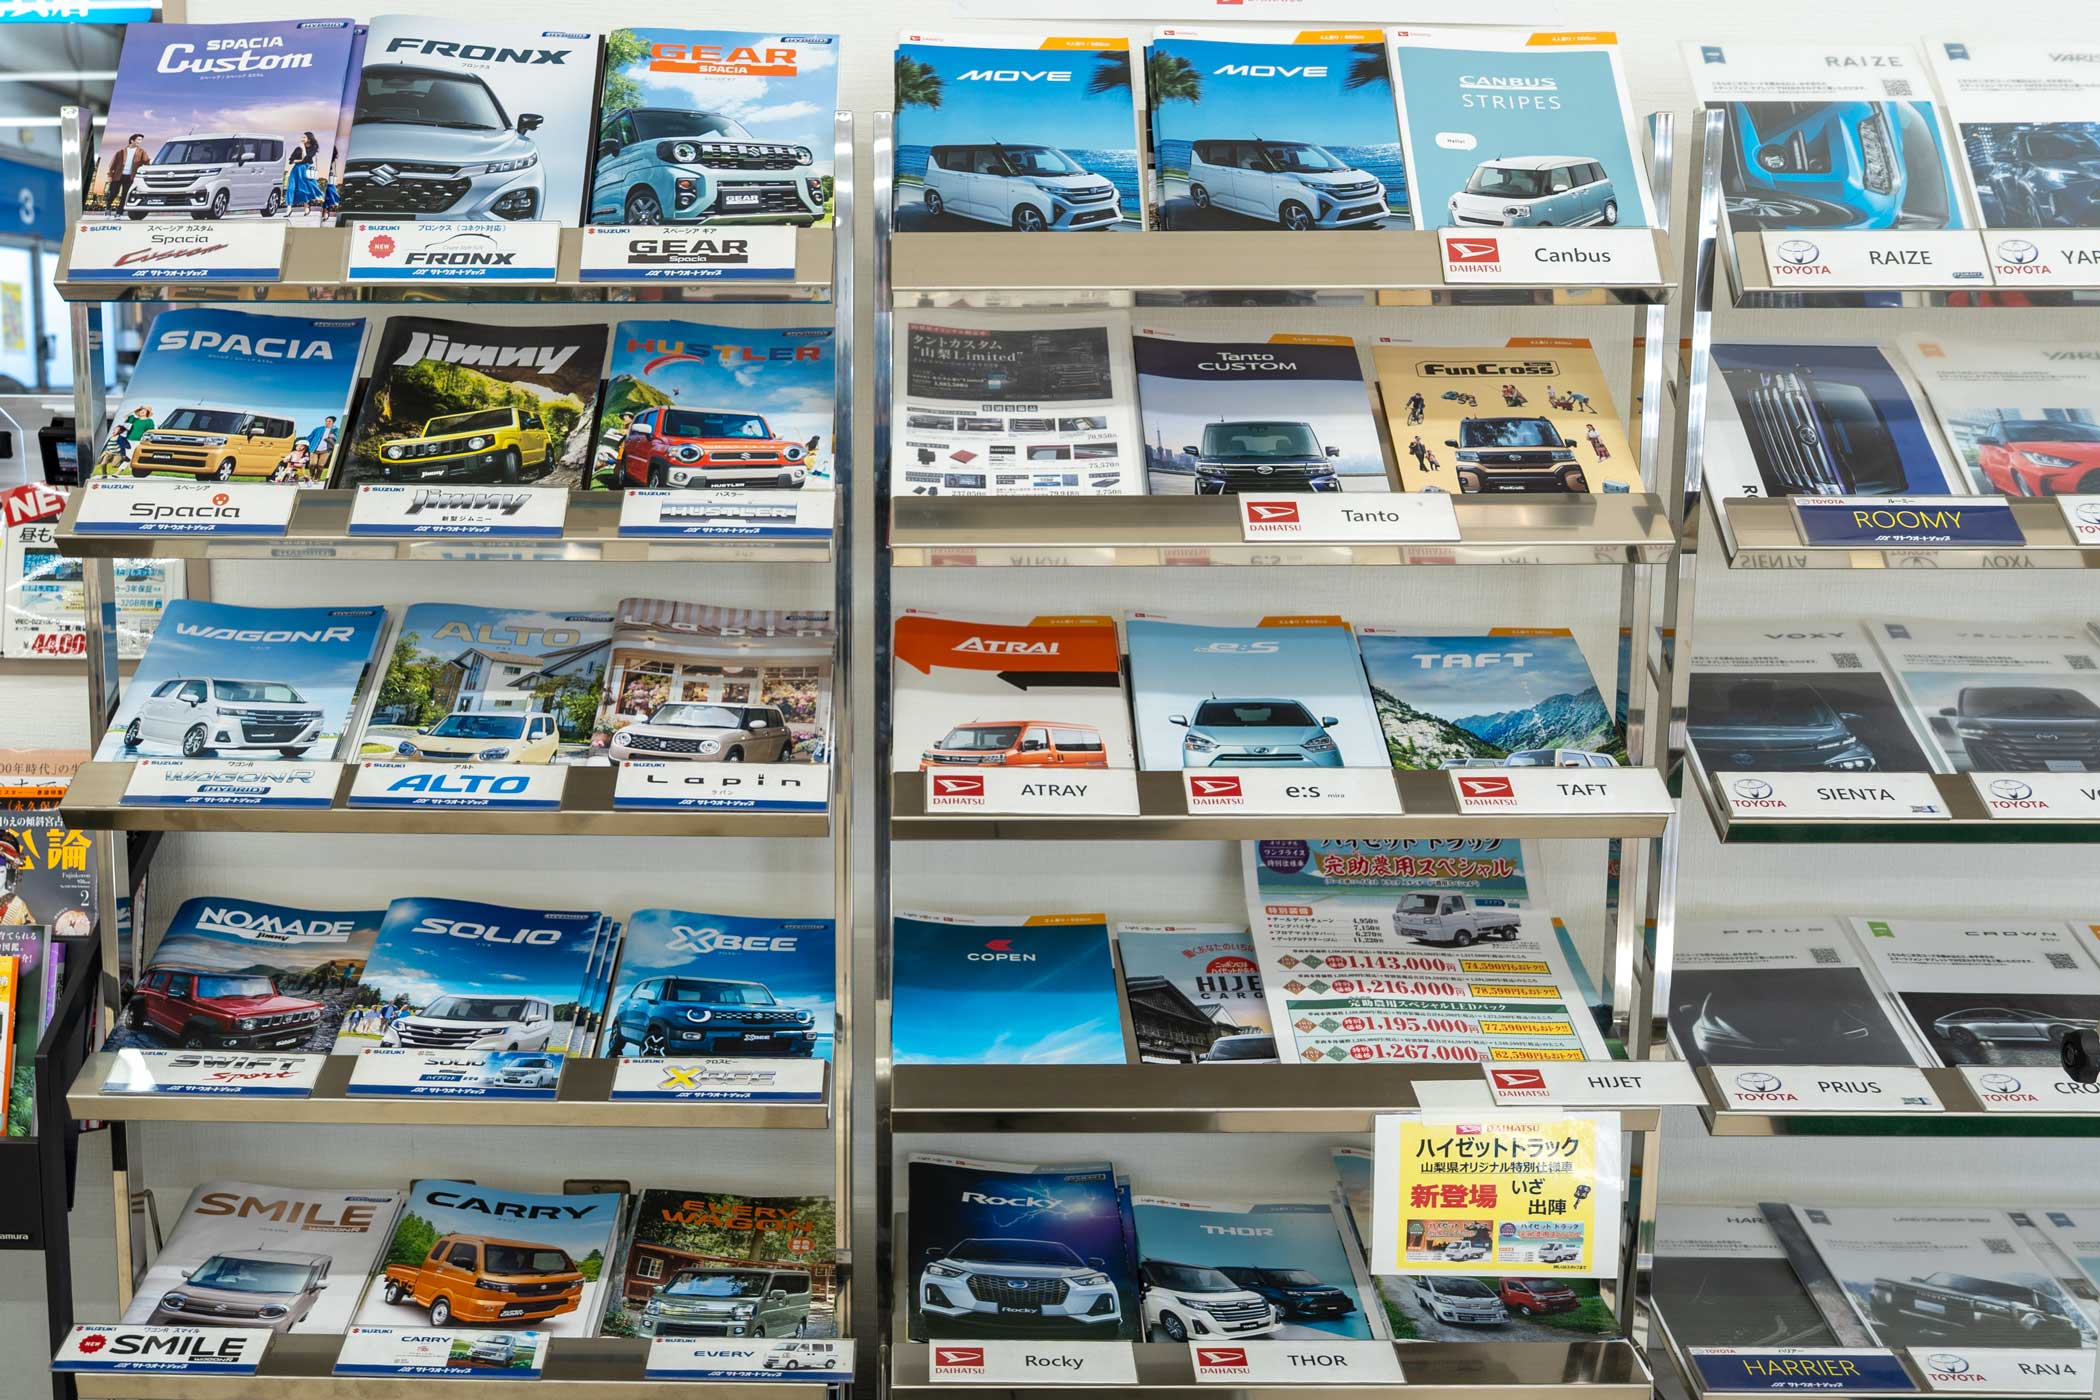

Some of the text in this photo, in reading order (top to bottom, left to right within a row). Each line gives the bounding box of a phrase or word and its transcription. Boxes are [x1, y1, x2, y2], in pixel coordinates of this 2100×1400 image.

[206, 36, 284, 50] SPACIA
[157, 43, 313, 74] Custom
[386, 38, 573, 65] FRONX
[650, 43, 797, 65] GEAR
[1824, 56, 1904, 67] RAIZE
[699, 65, 748, 74] SPACIA
[956, 70, 1073, 82] MOVE
[1213, 64, 1328, 78] MOVE
[1460, 75, 1557, 87] CANBUS
[1462, 94, 1561, 110] STRIPES
[19, 188, 34, 225] 3
[151, 234, 209, 245] Spacia
[628, 239, 748, 254] GEAR
[113, 244, 229, 267] Custom
[405, 252, 516, 265] FRONX
[669, 255, 707, 263] Spacia
[1534, 247, 1612, 263] Canbus
[1869, 250, 1933, 265] RAIZE
[1449, 264, 1502, 273] DAIHATSU
[1773, 265, 1831, 276] TOYOTA
[1995, 265, 2052, 275] TOYOTA
[156, 330, 334, 360] SPACIA
[626, 338, 821, 361] HUSTLER
[914, 335, 1003, 351] タントカスタム
[392, 331, 582, 375] Jimmy
[1216, 352, 1274, 361] Tanto
[1198, 362, 1297, 371] CUSTOM
[1424, 363, 1554, 376] FunCross
[129, 493, 240, 520] Spacia
[404, 489, 532, 515] Jimmy
[661, 504, 796, 518] HUSTLER
[1341, 509, 1400, 522] Tanto
[1853, 511, 1961, 529] ROOMY
[1249, 524, 1302, 532] DAIHATSU
[19, 528, 55, 543] 昼も
[432, 622, 581, 647] ALTO
[1764, 632, 1846, 640] VOXY
[952, 636, 1060, 655] ATRAI
[1411, 652, 1533, 669] TAFT
[386, 774, 531, 794] ALTO
[647, 774, 801, 787] Lapin
[204, 785, 263, 794] HYBRID
[1020, 784, 1088, 797] ATRAY
[1285, 784, 1321, 798] e:s
[1556, 784, 1607, 796] TAFT
[1816, 788, 1896, 801] SIENTA
[933, 797, 985, 806] DAIHATSU
[1192, 798, 1244, 806] DAIHATSU
[1465, 798, 1518, 806] DAIHATSU
[1732, 800, 1788, 809] TOYOTA
[1989, 801, 2050, 809] TOYOTA
[1323, 855, 1513, 878] 完助農用スペシャル
[80, 890, 90, 907] 2
[197, 906, 355, 937] NOMADE
[411, 918, 562, 945] SOLIO
[666, 925, 798, 953] XBEE
[967, 953, 1036, 961] COPEN
[168, 1055, 306, 1070] SWIFT
[424, 1058, 487, 1067] SOLIO
[202, 1071, 300, 1083] Sport
[658, 1064, 776, 1091] XBEE
[1587, 1076, 1642, 1089] HIJET
[1817, 1081, 1882, 1094] PRIUS
[2054, 1082, 2100, 1095] CRO
[1735, 1093, 1798, 1102] TOYOTA
[1981, 1094, 2039, 1103] TOYOTA
[1486, 1125, 1540, 1133] DAIHATSU
[1415, 1136, 1580, 1158] ハイゼットトラック
[1420, 1161, 1573, 1173] 山梨県オリジナル特別仕様車
[1511, 1178, 1546, 1196] いざ
[961, 1191, 1064, 1209] Rocky
[1411, 1184, 1498, 1209] 新登場
[194, 1192, 377, 1226] SMILE
[426, 1191, 599, 1220] CARRY
[682, 1200, 799, 1218] EVERY
[1528, 1199, 1567, 1216] 出陣
[662, 1209, 814, 1232] WAGON
[1200, 1225, 1275, 1238] THOR
[1001, 1306, 1038, 1314] Rocky
[108, 1334, 248, 1356] SMILE
[1025, 1354, 1084, 1370] Rocky
[1287, 1355, 1348, 1367] THOR
[1742, 1359, 1861, 1377] HARRIER
[2017, 1363, 2079, 1377] RAV4
[1928, 1373, 1987, 1382] TOYOTA
